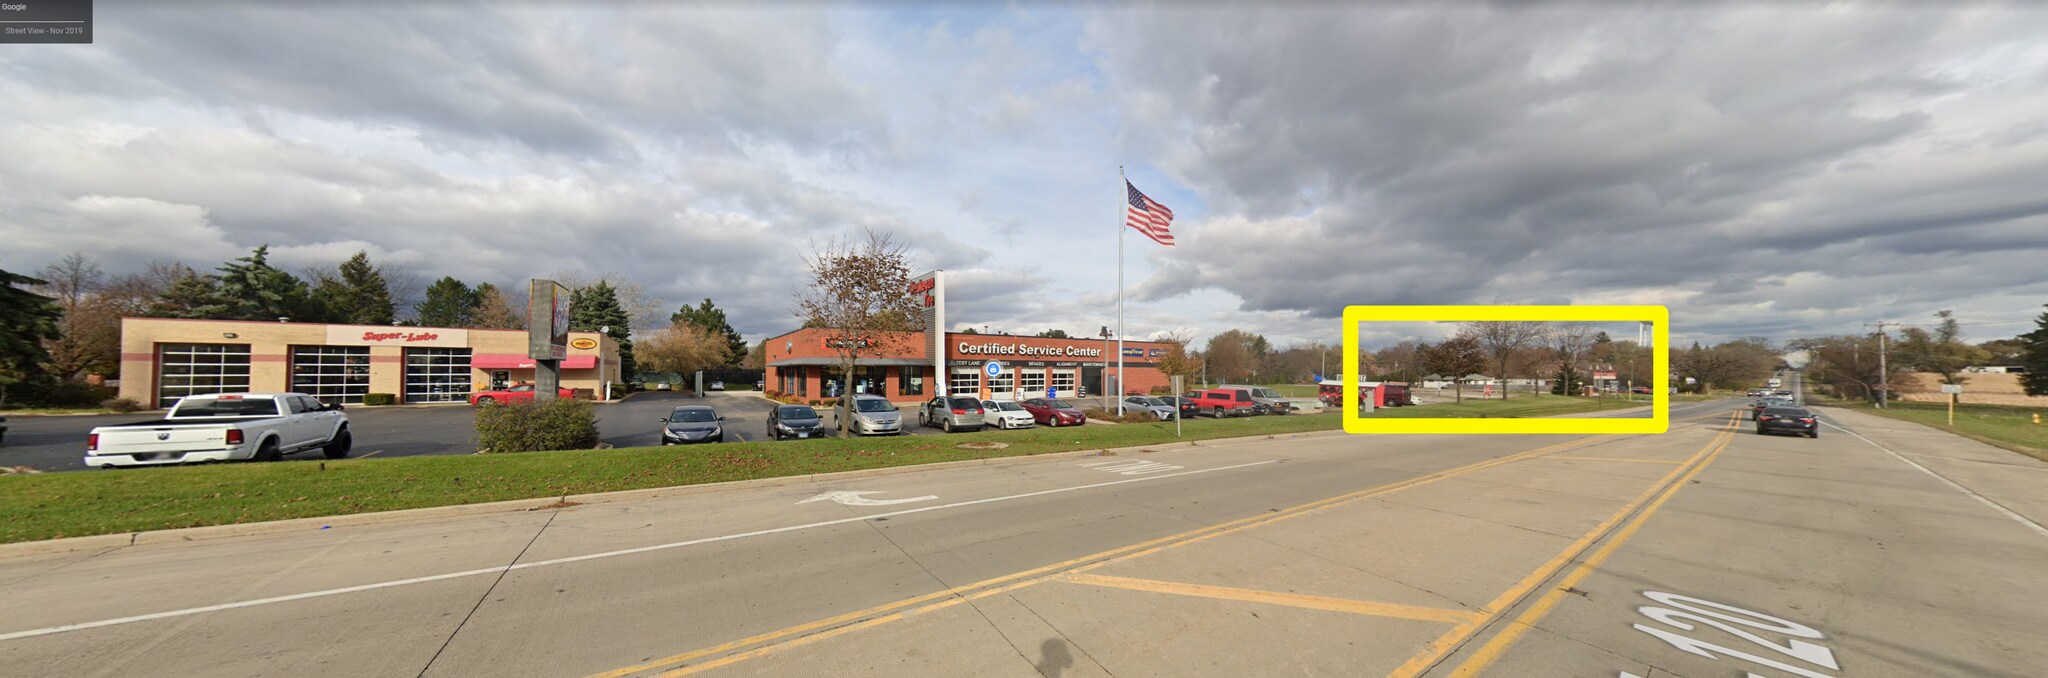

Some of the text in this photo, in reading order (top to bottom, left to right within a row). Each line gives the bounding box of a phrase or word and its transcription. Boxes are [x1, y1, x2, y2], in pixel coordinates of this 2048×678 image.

[362, 331, 438, 342] Super-Lube
[958, 341, 1102, 357] Certified Service Center
[1633, 590, 1840, 678] 120
